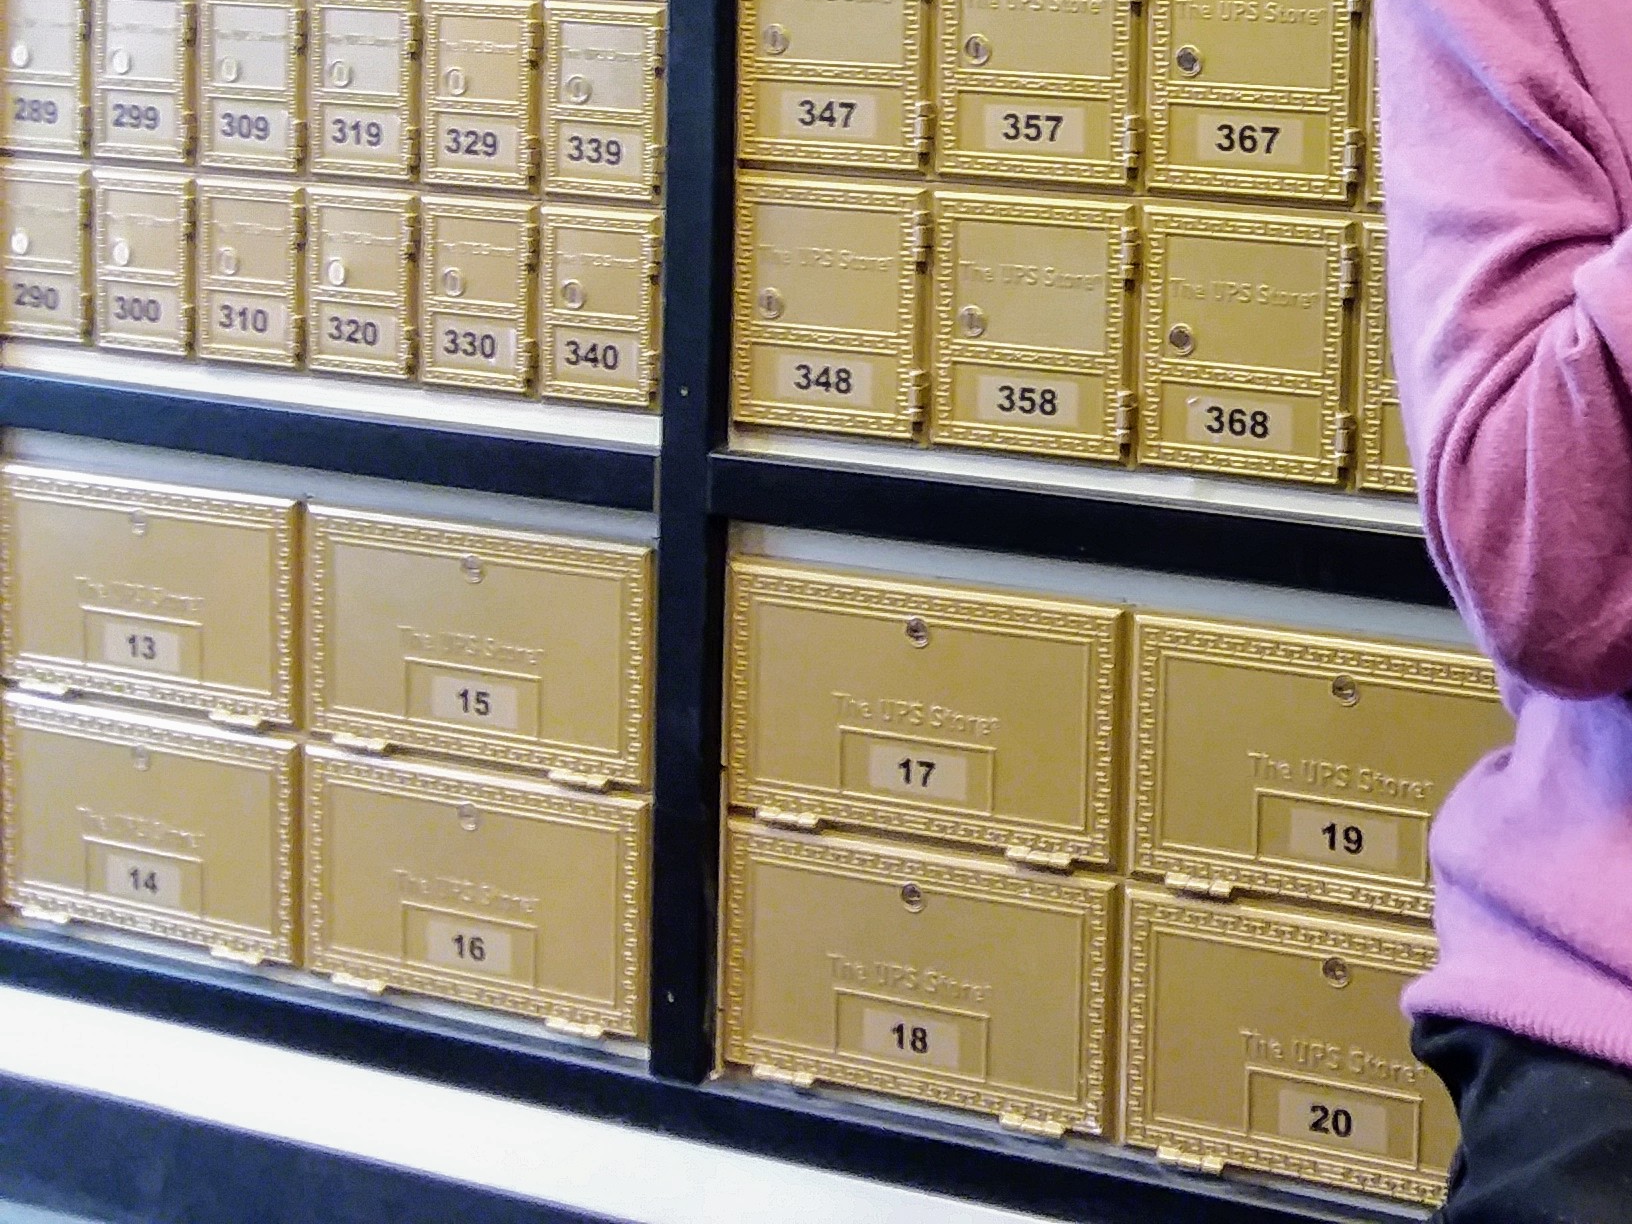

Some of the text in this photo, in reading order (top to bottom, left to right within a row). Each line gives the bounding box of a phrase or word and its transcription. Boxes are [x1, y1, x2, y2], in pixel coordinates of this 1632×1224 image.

[1218, 0, 1260, 23] UPS
[14, 98, 57, 124] 289
[113, 104, 159, 130] 299
[799, 100, 855, 127] 347
[221, 113, 269, 140] 309
[332, 119, 381, 146] 319
[1003, 114, 1063, 141] 357
[1217, 124, 1280, 153] 367
[446, 129, 497, 157] 329
[568, 136, 621, 165] 339
[13, 283, 57, 310] 290
[115, 297, 160, 322] 300
[219, 305, 268, 333] 310
[329, 317, 377, 346] 320
[444, 330, 495, 358] 330
[566, 341, 618, 370] 340
[795, 365, 851, 394] 348
[998, 386, 1057, 415] 358
[1207, 406, 1268, 438] 368
[128, 635, 155, 659] 13
[459, 689, 489, 715] 15
[899, 759, 935, 786] 17
[1323, 823, 1363, 854] 19
[130, 869, 157, 892] 14
[454, 935, 485, 961] 16
[893, 1024, 927, 1053] 18
[1310, 1105, 1351, 1137] 20
